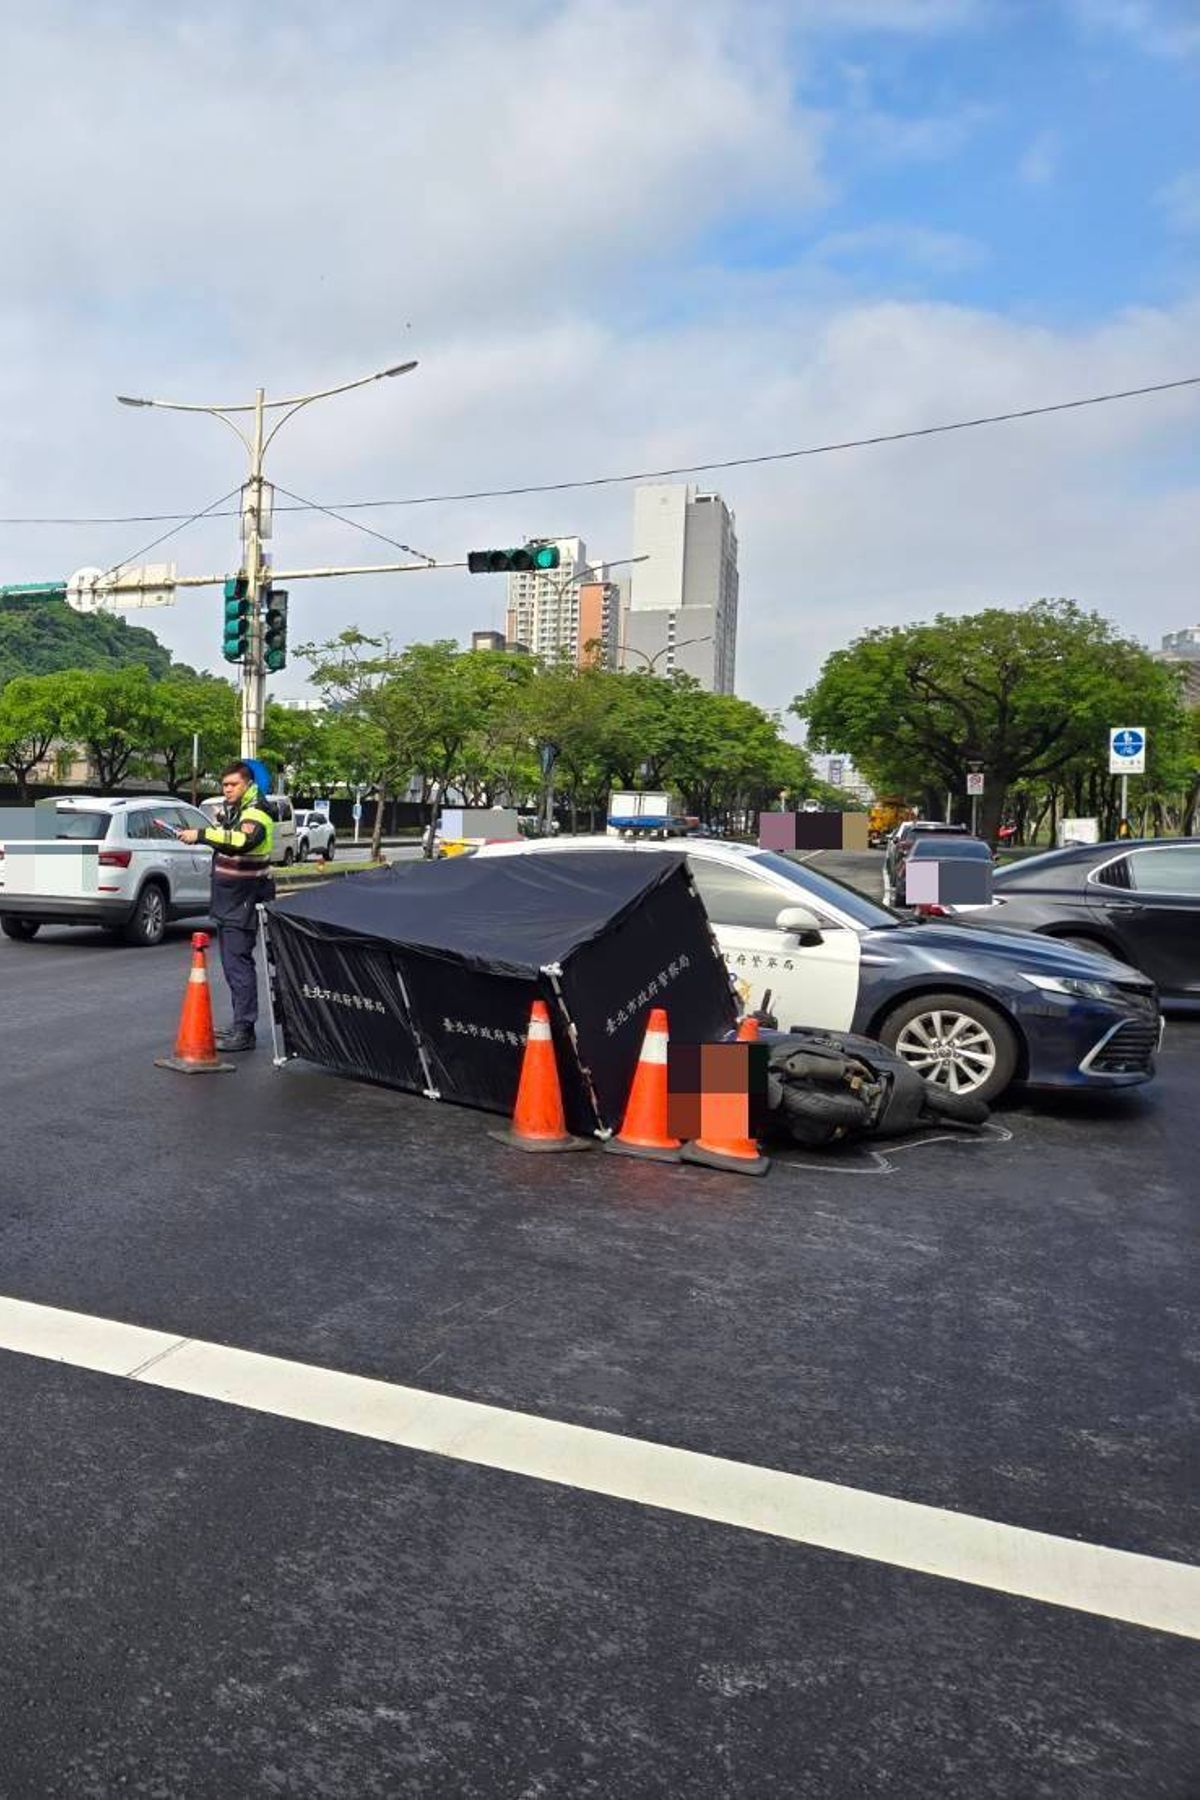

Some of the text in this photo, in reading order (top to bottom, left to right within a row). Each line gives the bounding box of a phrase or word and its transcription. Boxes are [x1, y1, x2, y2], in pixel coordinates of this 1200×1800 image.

[606, 954, 689, 1036] 臺北市政府警察局
